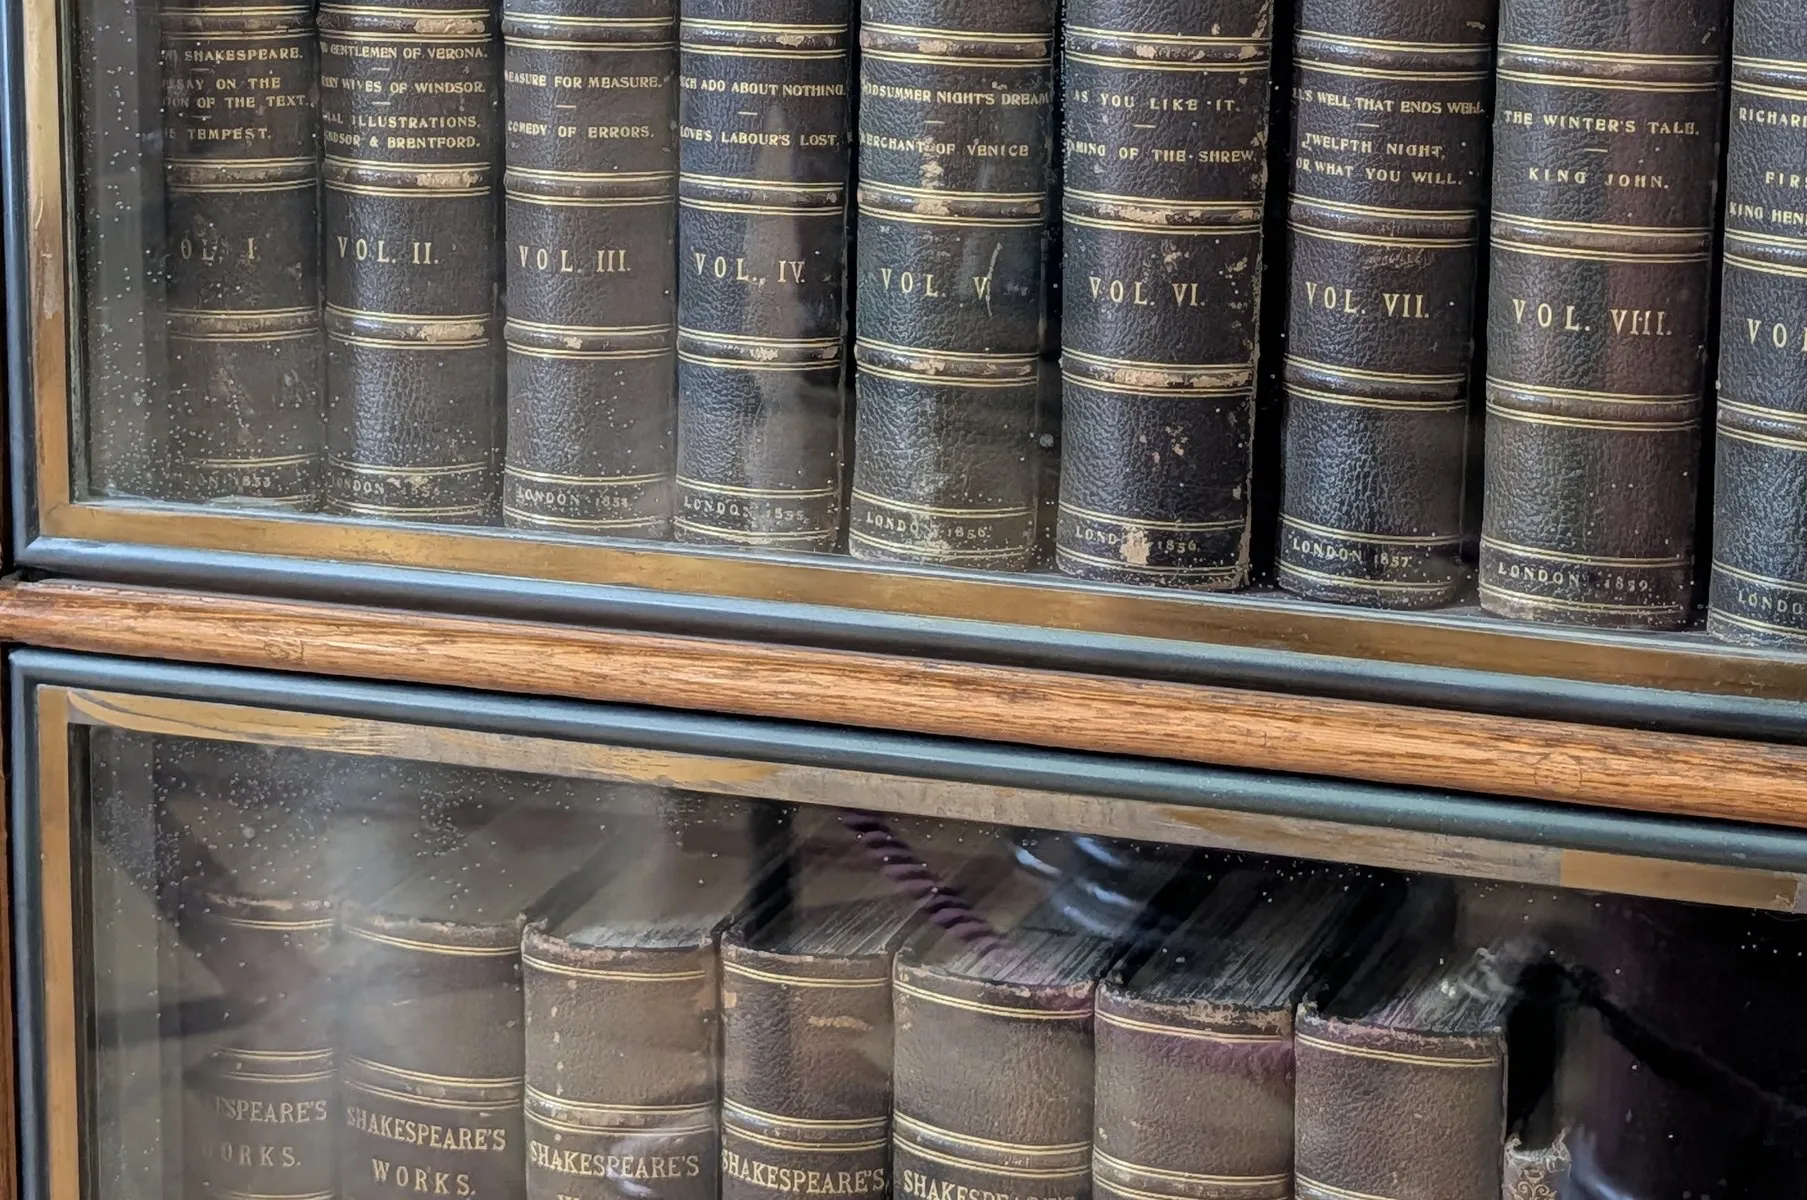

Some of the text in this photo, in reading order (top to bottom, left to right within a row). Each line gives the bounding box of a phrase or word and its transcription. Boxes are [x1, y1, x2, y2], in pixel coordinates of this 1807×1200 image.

[184, 47, 304, 62] SHAKESPEARE.
[330, 45, 397, 59] GENTLEMEN
[402, 47, 421, 59] OF
[427, 46, 488, 60] VERONA.
[215, 78, 237, 91] ON
[248, 77, 281, 90] THE
[341, 77, 382, 92] WIVES
[390, 82, 408, 93] OF
[554, 76, 582, 88] FOR
[588, 75, 662, 89] MEASURE.
[700, 79, 726, 92] ADO
[731, 81, 778, 96] ABOUT
[197, 97, 216, 109] OF
[224, 97, 256, 109] THE
[266, 95, 308, 107] TEXT.
[936, 90, 994, 105] NIGHT'S
[1073, 90, 1089, 103] AS
[1100, 93, 1135, 108] YOU
[1150, 98, 1198, 111] LIKE
[1317, 91, 1351, 107] WELL
[1354, 97, 1394, 112] THAT
[1400, 101, 1442, 114] ENDS
[351, 115, 481, 129] ILLUSTRATIONS.
[508, 120, 655, 139] COMEDY OF ERRORS.
[1504, 110, 1699, 136] THE WINTER'S TALE.
[187, 127, 272, 140] TEMPEST.
[369, 135, 379, 148] &
[387, 136, 481, 150] BRENTFORD.
[721, 131, 791, 146] LABOUR'S
[800, 134, 840, 146] LOST.
[1304, 132, 1372, 153] TWELFTH
[936, 143, 956, 155] OF
[1119, 147, 1139, 161] OF
[1151, 149, 1186, 162] THE
[1315, 160, 1353, 178] WHAT
[1365, 167, 1400, 182] YOU
[1411, 171, 1462, 185] WILL.
[1529, 166, 1669, 190] KING JOHN.
[1729, 201, 1764, 220] KING
[337, 236, 439, 264] VOL. II.
[596, 249, 631, 273] III.
[694, 252, 806, 283] VOL. IV.
[881, 268, 946, 299] VOL.
[1089, 276, 1155, 306] VOL.
[1305, 281, 1429, 319] VOL. VII.
[1512, 298, 1672, 336] VOL. VIII.
[346, 1106, 507, 1152] SHAKESPEARE'S
[530, 1139, 700, 1181] SHAKESPEARE'S
[372, 1158, 477, 1196] WORKS.
[721, 1148, 885, 1195] SHAKESPEARE'S
